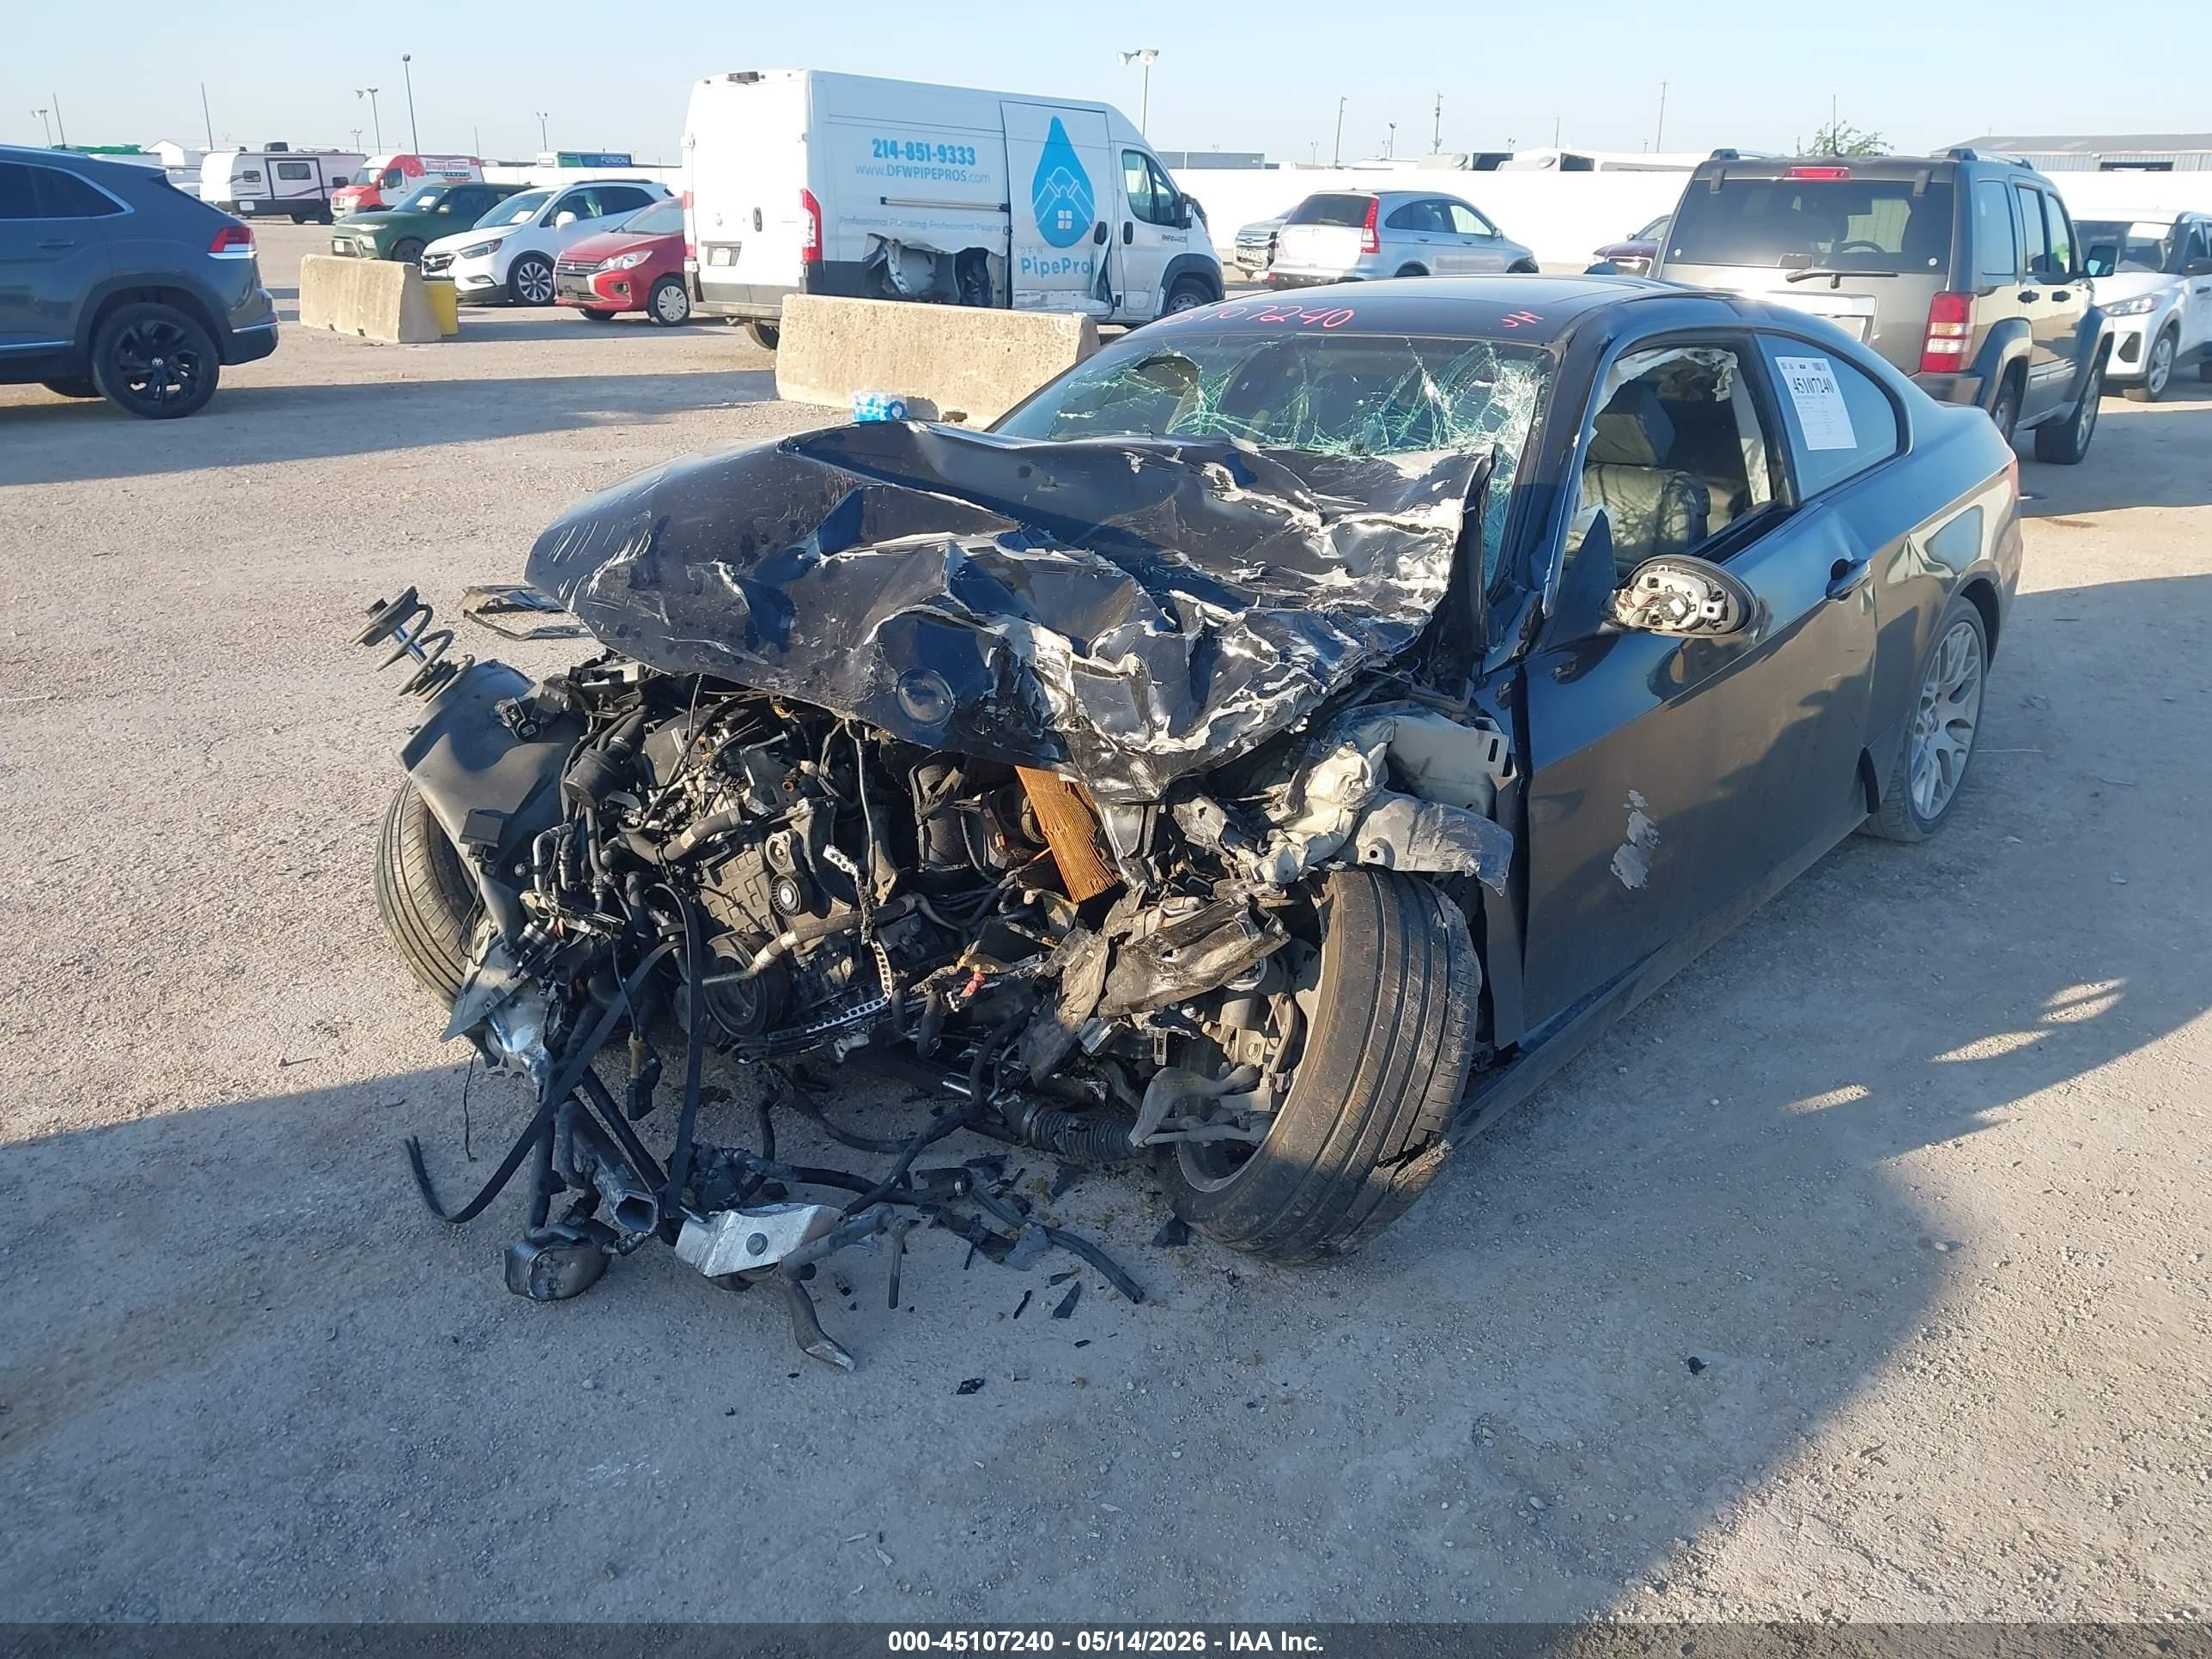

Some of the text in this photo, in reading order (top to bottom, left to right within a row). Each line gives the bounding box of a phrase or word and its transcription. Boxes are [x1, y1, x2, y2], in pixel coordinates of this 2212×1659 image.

[872, 137, 976, 166] 214-851-9333
[855, 163, 991, 184] www.DFWPIPEPROS.com
[1792, 377, 1835, 393] 45107240
